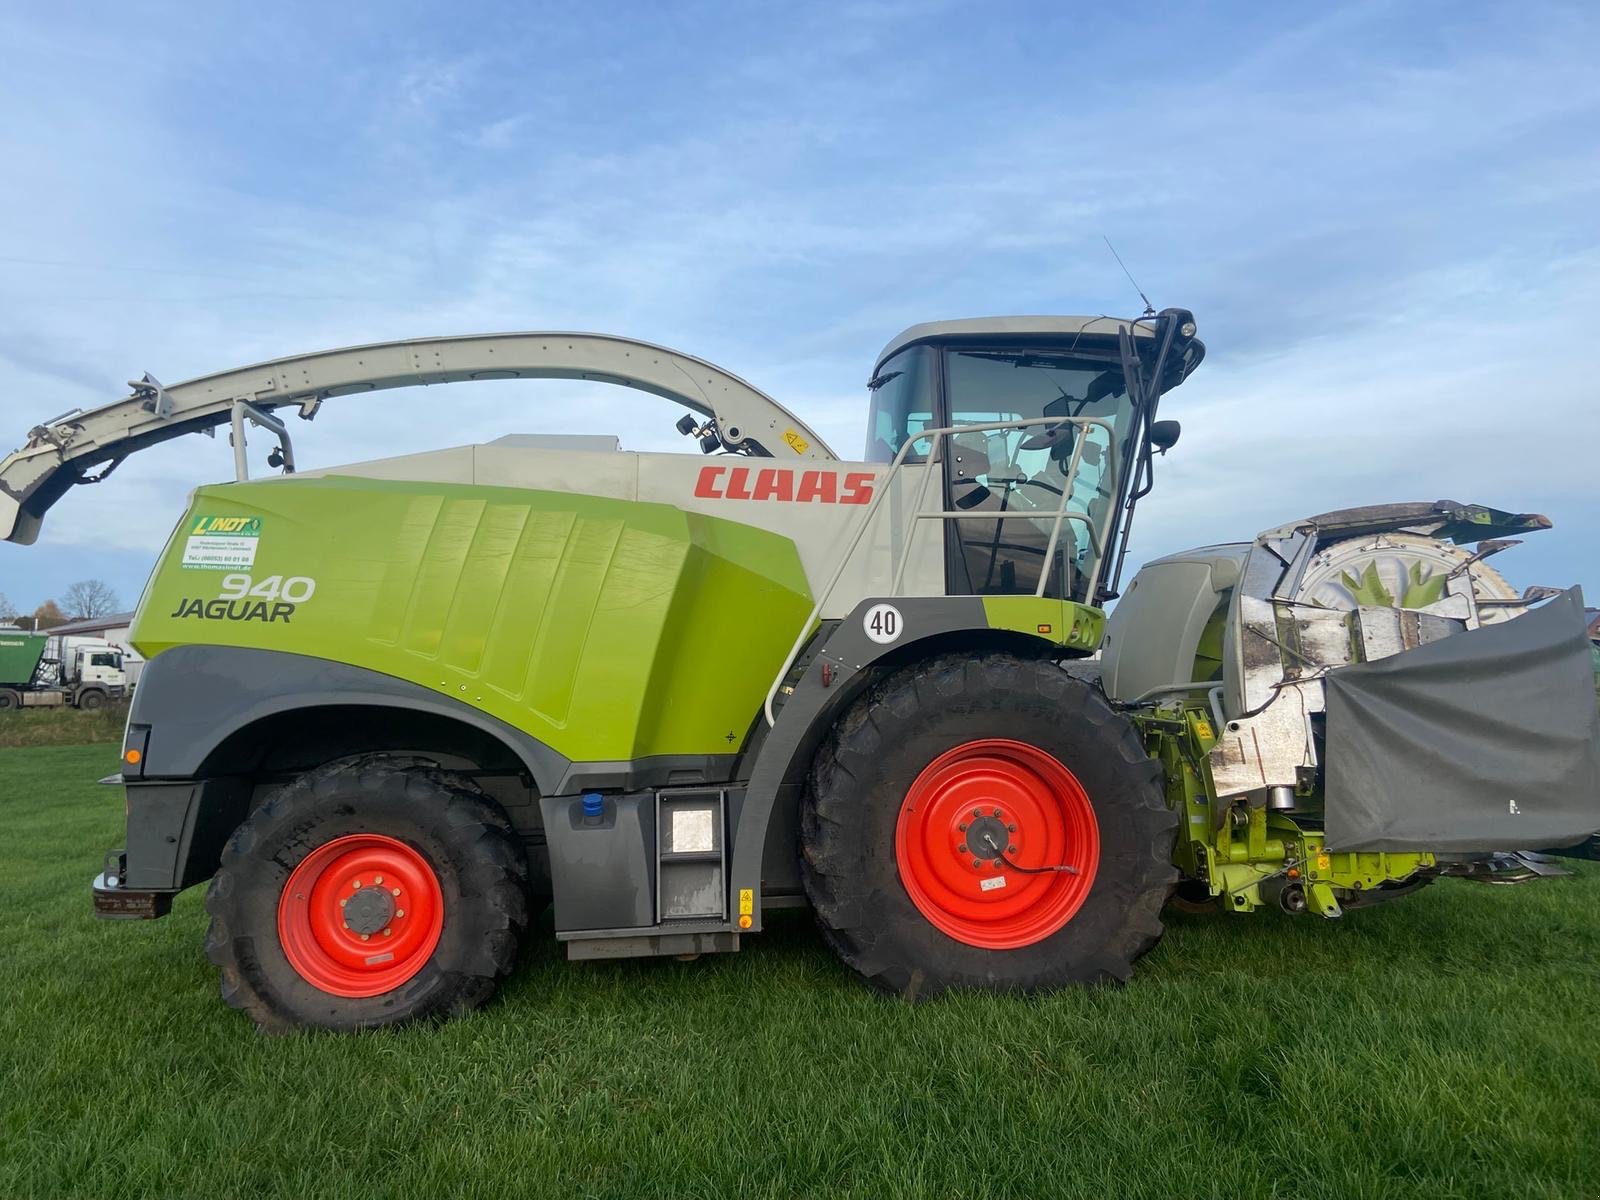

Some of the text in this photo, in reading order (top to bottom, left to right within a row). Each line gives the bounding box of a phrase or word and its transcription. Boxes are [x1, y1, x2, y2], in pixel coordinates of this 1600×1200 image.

[694, 466, 876, 505] CLAAS
[192, 517, 251, 535] LINDT
[219, 573, 316, 603] 940
[171, 598, 296, 623] JAGUAR
[870, 611, 896, 635] 40
